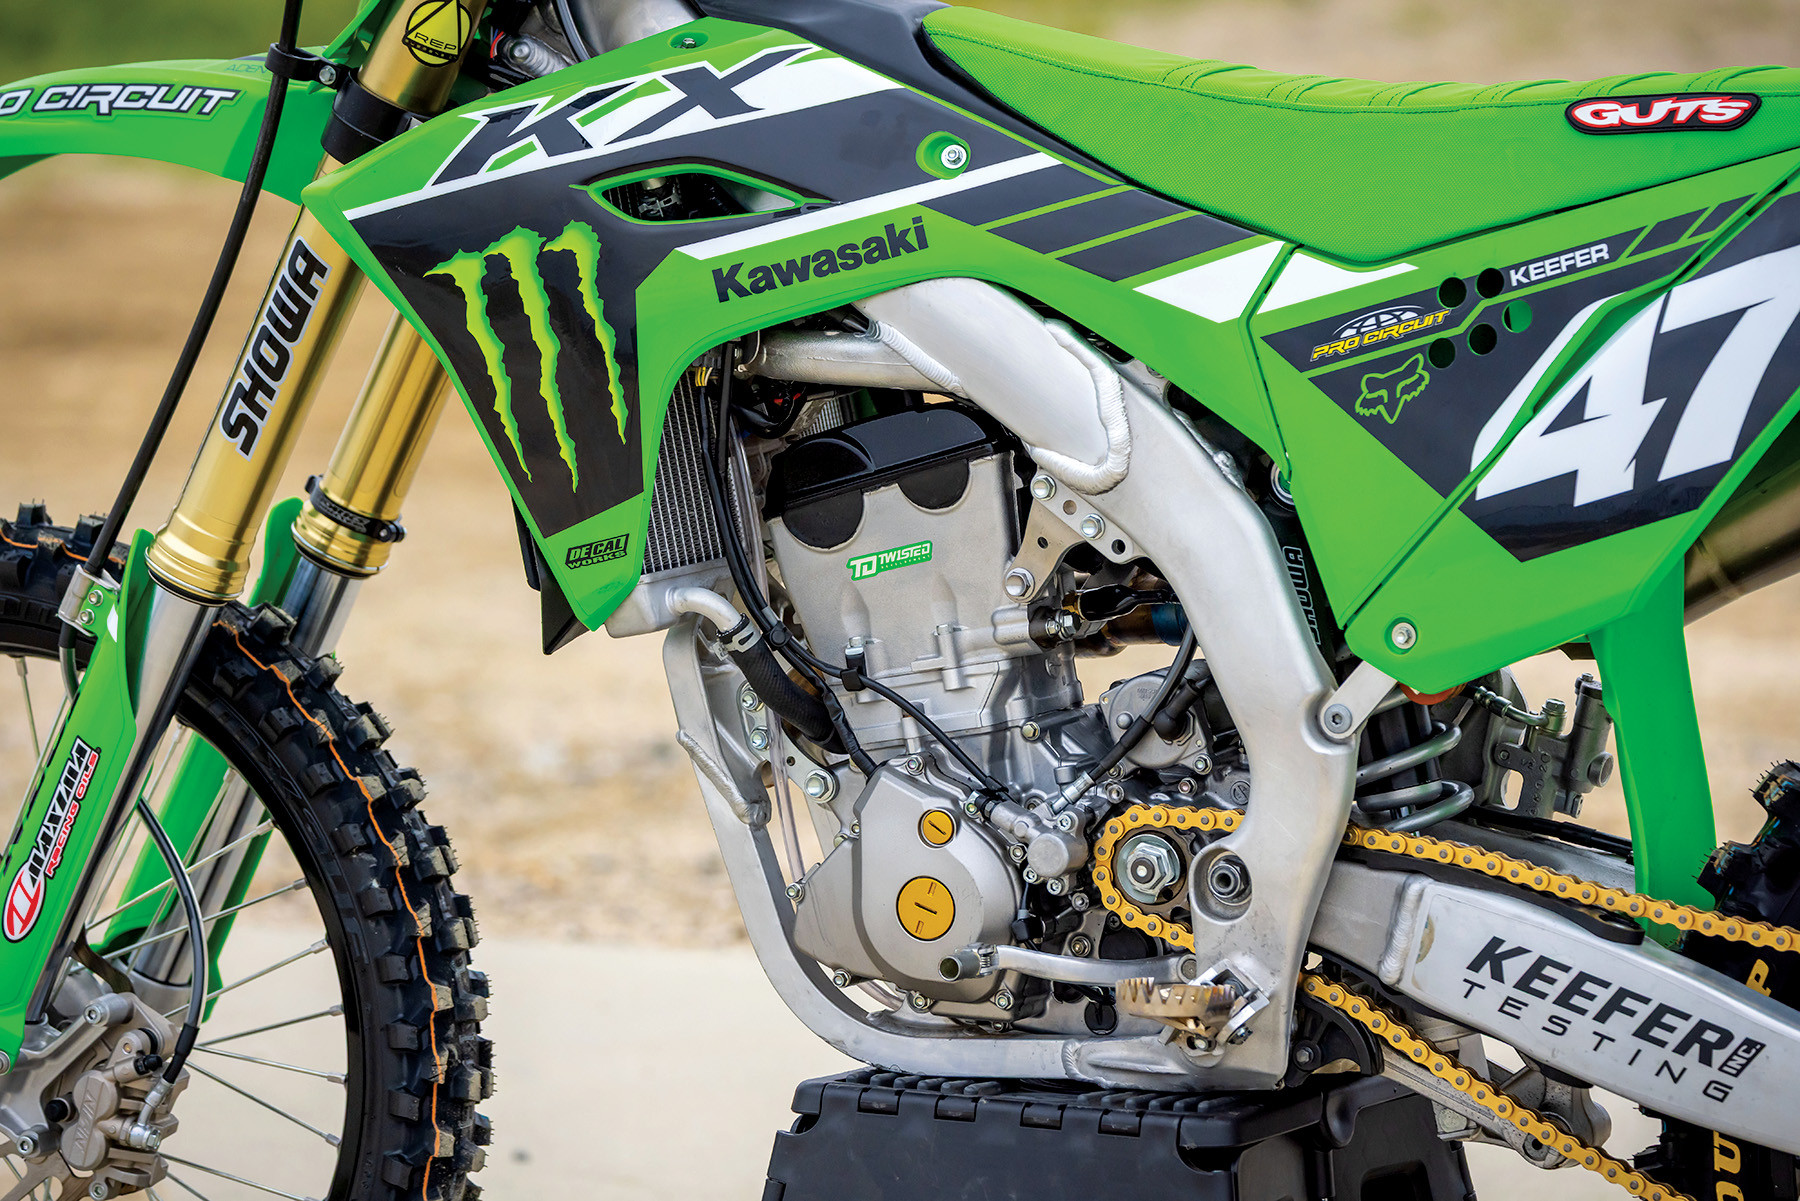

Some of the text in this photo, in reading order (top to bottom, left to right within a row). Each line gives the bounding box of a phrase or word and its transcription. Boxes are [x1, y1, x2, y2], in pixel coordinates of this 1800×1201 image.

[414, 32, 457, 51] REP
[32, 84, 242, 116] CIRCUIT
[431, 47, 813, 186] KX
[1572, 96, 1752, 128] GUTS
[712, 216, 929, 303] Kawasaki
[1509, 243, 1610, 287] KEEFER
[220, 237, 331, 460] SHOWA
[1311, 308, 1451, 361] PRO CIRCUIT
[1470, 244, 1800, 508] 47
[567, 550, 626, 568] WORKS
[569, 535, 627, 561] DECAL
[879, 543, 930, 565] TWISTED
[46, 751, 99, 878] RACING OILS
[1466, 935, 1765, 1077] KEEFER INC.
[1463, 978, 1733, 1102] TESTING
